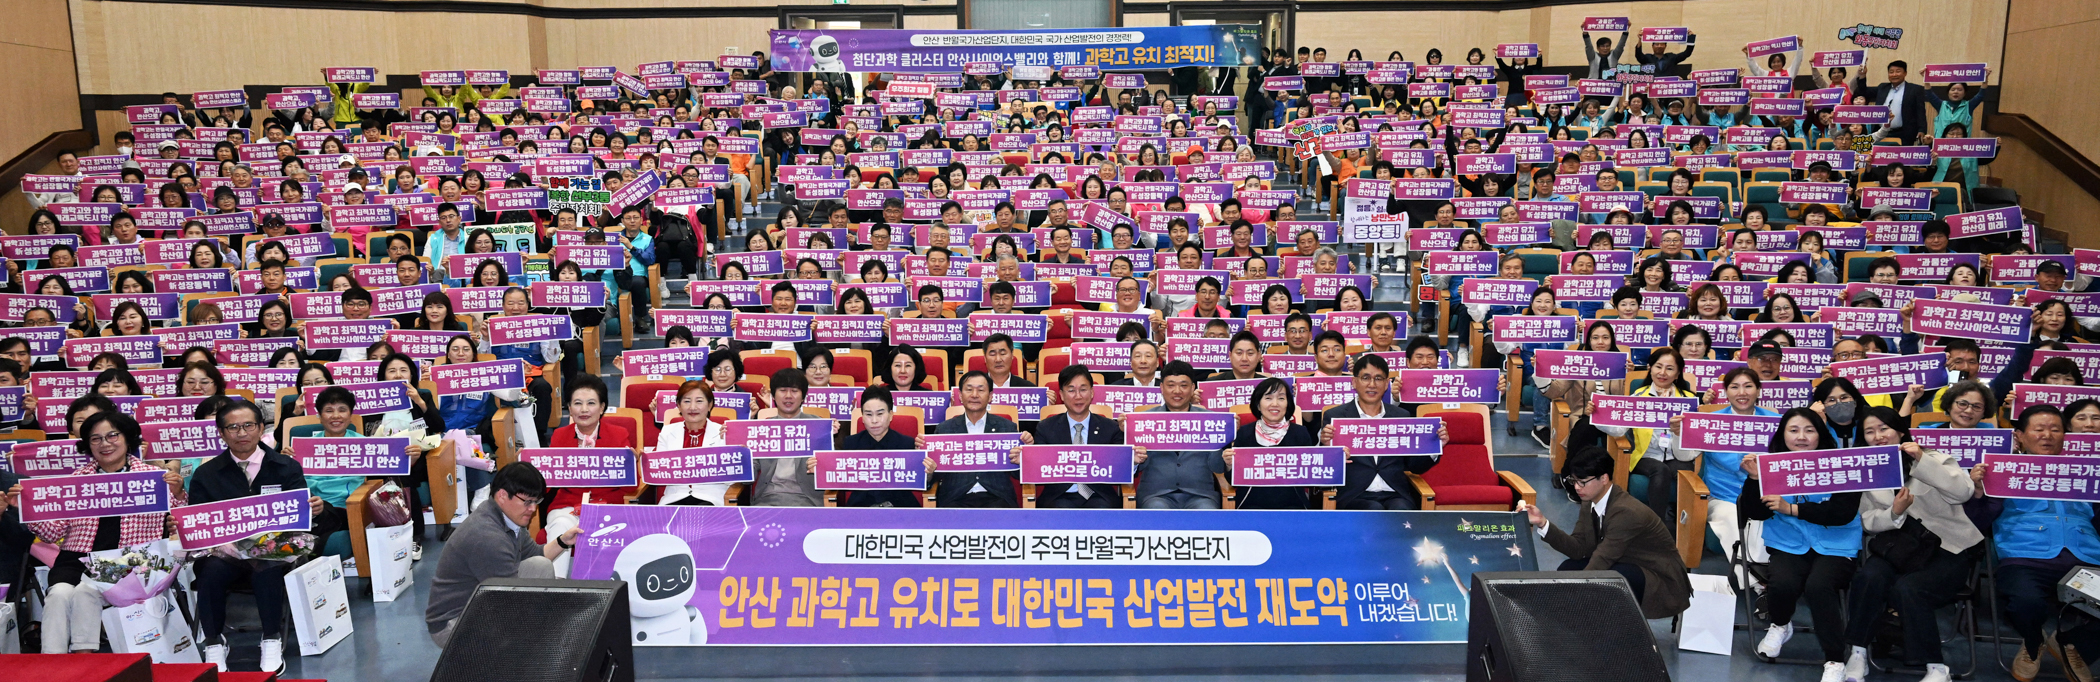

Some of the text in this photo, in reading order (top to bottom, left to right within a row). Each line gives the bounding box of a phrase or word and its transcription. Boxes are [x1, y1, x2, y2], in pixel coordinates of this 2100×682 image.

[923, 36, 940, 44] 안산
[943, 36, 1009, 45] 반월국가산업단지,
[1011, 36, 1043, 44] 대한민국
[1106, 34, 1132, 42] 경쟁력!
[853, 53, 897, 66] 첨단과학
[901, 53, 944, 66] 클러스터
[1053, 52, 1080, 65] 함께!
[1085, 48, 1129, 66] 과학고
[1132, 46, 1161, 65] 유치
[1165, 45, 1214, 64] 최적지!
[570, 178, 590, 190] 가는
[571, 190, 610, 203] 선부3동
[1962, 212, 2006, 225] 과학고 유치,
[1962, 217, 2007, 233] 안산의 미래!
[1354, 224, 1400, 239] 중앙동!
[546, 285, 590, 294] 과학고 유치,
[572, 295, 590, 303] 미래!
[1922, 306, 2023, 324] 과학고 최적지 안산
[494, 317, 565, 330] 과학고는 반월국가공단
[896, 324, 963, 332] 과학고 최적지 안산
[1920, 319, 2020, 335] with 안산사이언스밸리
[1432, 374, 1467, 386] 과학고,
[1417, 387, 1481, 398] 안산으로 Go!
[748, 425, 810, 438] 과학고 유치,
[1340, 424, 1434, 434] 과학고는 반월국가공단
[314, 444, 388, 455] 과학고와 함께
[746, 439, 810, 452] 안산의 미래!
[926, 440, 1020, 452] 과학고는 반월국가공단
[303, 456, 400, 468] 미래교육도시 안산
[649, 452, 742, 469] 과학고 최적지 안산
[836, 457, 905, 470] 과학고와 함께
[1057, 452, 1096, 464] 과학고,
[1254, 453, 1323, 466] 과학고와 함께
[1769, 454, 1890, 472] 과학고는 반월국가공단
[673, 465, 743, 478] 안산사이언스밸리
[826, 471, 917, 482] 미래교육도시 안산
[1041, 465, 1112, 478] 안산으로 Go!
[1244, 467, 1334, 479] 미래교육도시 안산
[32, 480, 156, 500] 과학고 최적지 안산
[33, 494, 157, 512] with 안산사이언스밸리
[182, 499, 299, 528] 과학고 최적지 안산
[185, 513, 299, 540] with 안산사이언스밸리
[588, 538, 624, 547] 안산시
[845, 534, 1230, 561] 대한민국 산업발전의 주역 반월국가산업단지
[1354, 583, 1409, 602] 이루어
[719, 576, 1349, 628] 안산 과학고 유치로 대한민국 산업발전 재도약
[1359, 603, 1459, 623] 내겠습니다!
